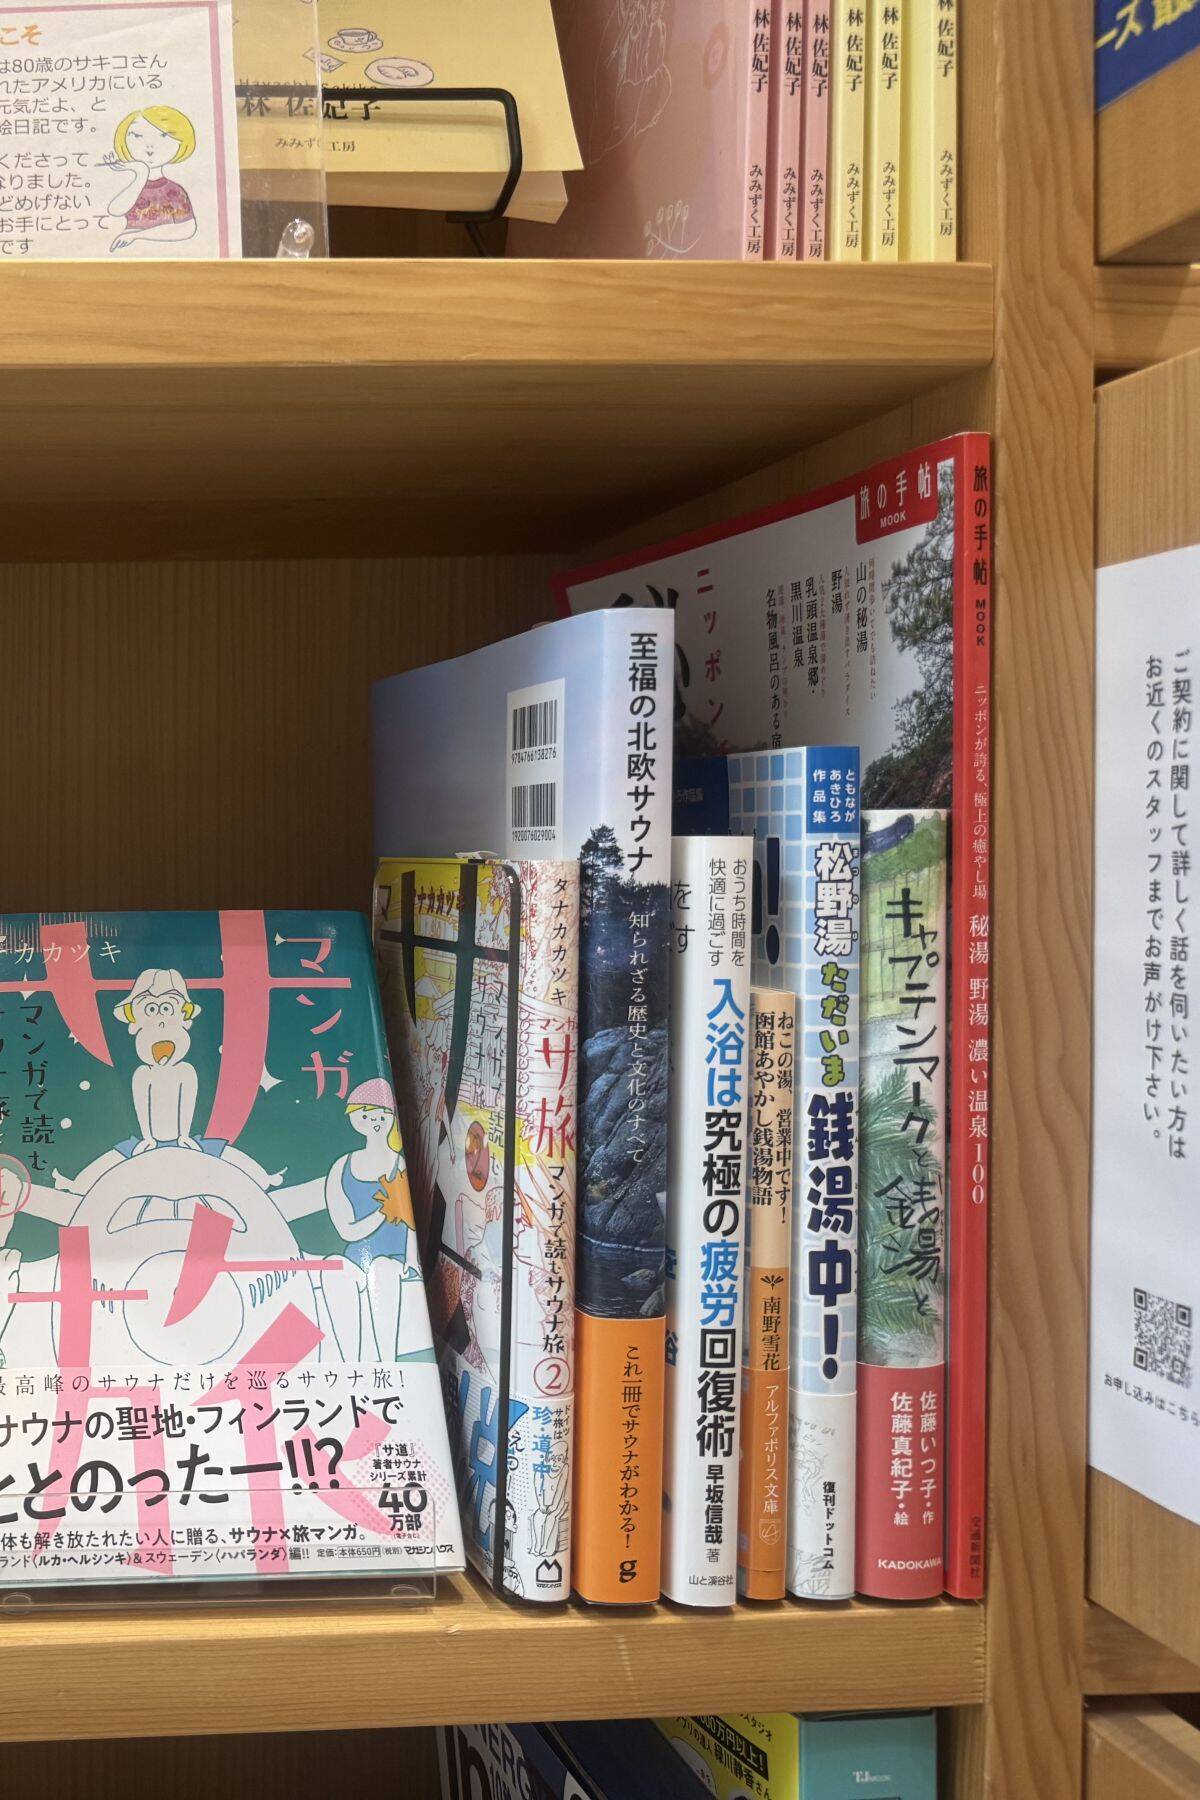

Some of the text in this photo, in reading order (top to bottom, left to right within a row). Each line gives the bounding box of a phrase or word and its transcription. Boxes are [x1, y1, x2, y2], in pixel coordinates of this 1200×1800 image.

[747, 164, 762, 254] みみずく工房
[781, 167, 796, 257] みみずく工房
[809, 169, 823, 257] みみずく工房
[845, 163, 860, 248] みみずく工房
[881, 161, 896, 246] みみずく工房
[940, 150, 953, 236] みみずく工房
[860, 461, 931, 520] 旅の手帖
[880, 511, 907, 528] MOOK
[790, 581, 805, 667] 黒川温泉
[831, 569, 843, 614] 野湯
[856, 562, 868, 653] 山の秘湯
[975, 600, 986, 646] MOOK
[766, 588, 783, 749] 名物風呂のある宿
[511, 747, 557, 765] 9784766138276
[627, 632, 658, 873] 至福の北欧サウナ
[813, 769, 826, 823] 作品集
[830, 769, 841, 823] あきひろ
[845, 769, 856, 823] ともなが
[511, 829, 556, 842] 1920076029004
[708, 858, 727, 967] 快適に過ごす
[731, 858, 747, 967] おうち時間を
[1143, 655, 1164, 1138] お近くのスタッフまでお声がけ下さい。
[1167, 649, 1192, 1158] ご契約に関して詳しく話を伺いたい方は
[550, 878, 568, 1007] タナカカツキ
[287, 937, 355, 1100] マンガ
[537, 1016, 578, 1034] マンガ
[627, 911, 654, 1163] 知られざる歴史と文化のすべて
[20, 1005, 55, 1171] マンガで読む
[535, 1033, 577, 1159] サ旅
[752, 1012, 774, 1206] 函館あやかし銭湯物語
[874, 888, 941, 1317] キャプテンマークと銭湯と
[543, 1165, 569, 1354] マンガで読むサウナ旅
[696, 978, 745, 1458] 入浴は究極の疲労回復術
[761, 1297, 781, 1371] 南野雪花
[372, 1459, 422, 1470] 著者サウナ
[553, 1407, 563, 1440] サ旅は
[619, 1346, 644, 1549] これ一冊でサウナがわかる!
[763, 1385, 780, 1514] アルファポリス文庫
[891, 1391, 913, 1527] 佐藤真紀子・絵
[920, 1391, 937, 1525] 佐藤いつ子・作
[370, 1471, 427, 1482] シリーズ累計
[378, 1482, 428, 1513] 40
[704, 1464, 725, 1545] 早坂信哉
[388, 1513, 422, 1531] 万部
[822, 1481, 836, 1570] 復刊ドットコム
[878, 1558, 942, 1571] KADOKAWA
